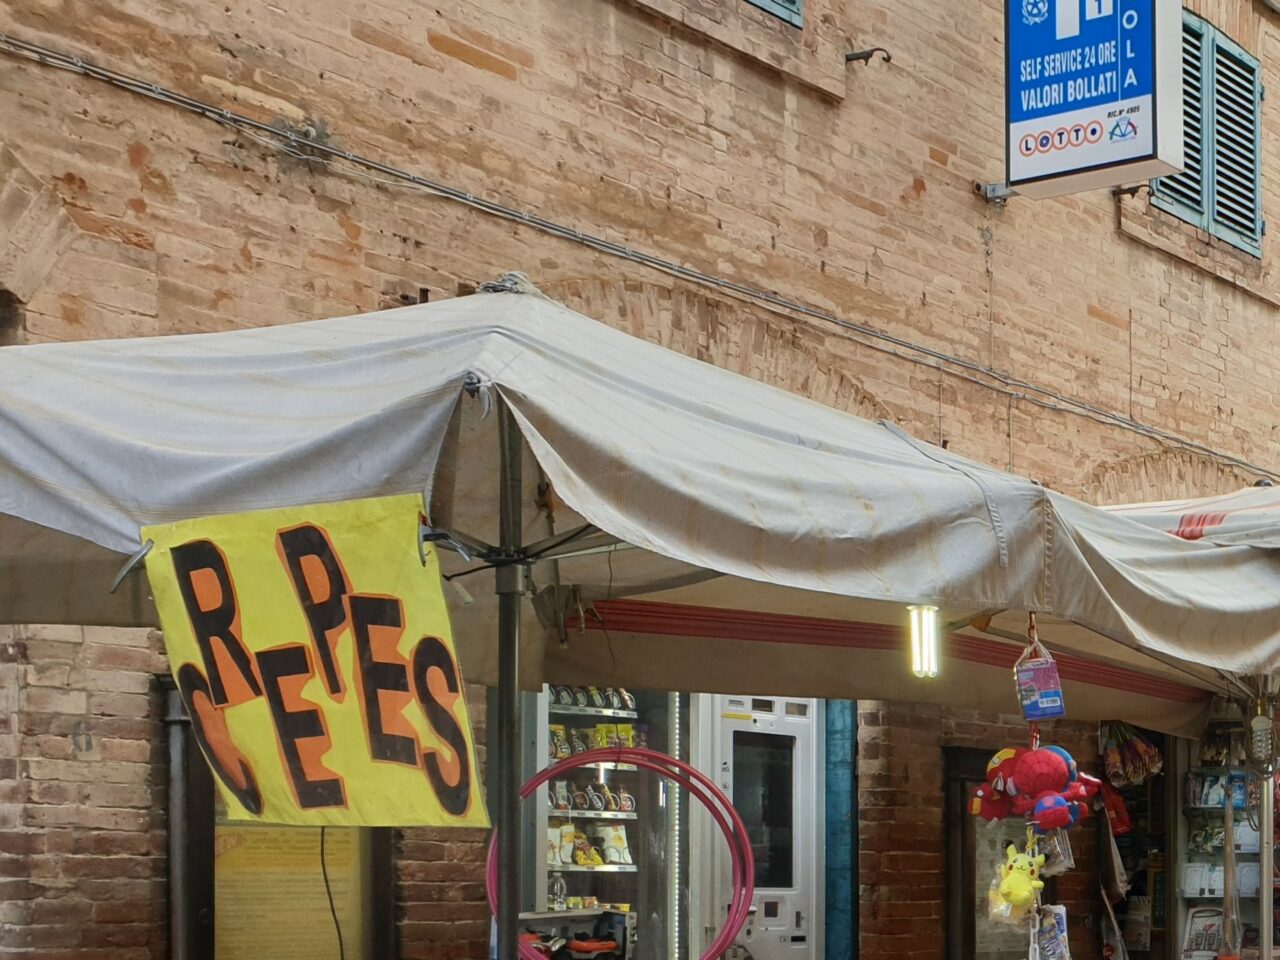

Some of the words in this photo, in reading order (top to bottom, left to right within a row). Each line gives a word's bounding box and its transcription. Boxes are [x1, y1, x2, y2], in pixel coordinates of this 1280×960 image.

[1021, 57, 1041, 82] SELF
[1044, 48, 1081, 77] SERVICE
[1085, 46, 1095, 68] 24
[1098, 40, 1116, 63] ORE
[1021, 83, 1063, 111] VALORI
[1067, 71, 1116, 102] BOLLATI
